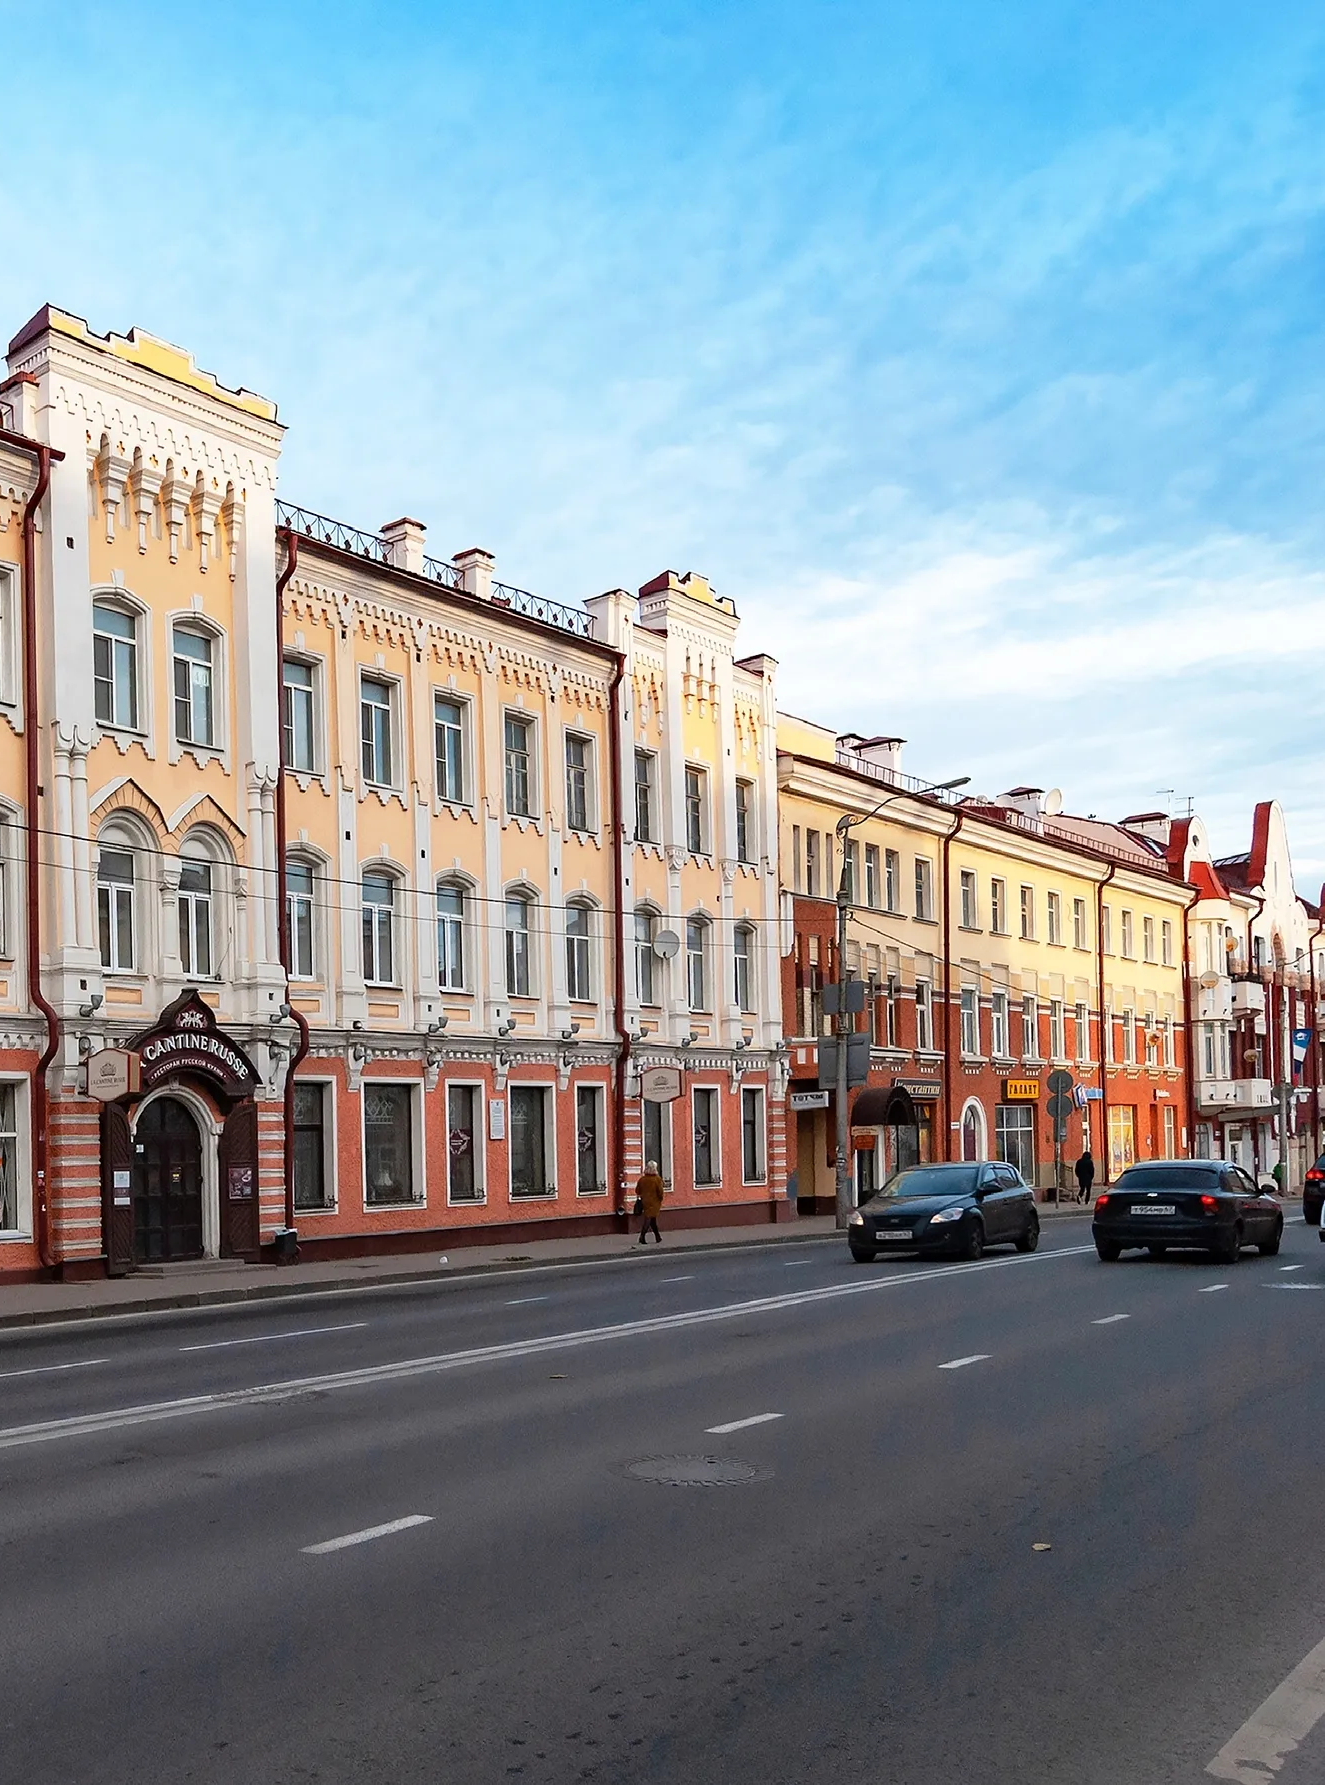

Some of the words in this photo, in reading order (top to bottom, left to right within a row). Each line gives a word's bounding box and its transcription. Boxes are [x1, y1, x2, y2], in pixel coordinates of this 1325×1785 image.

[146, 1034, 208, 1061] CANTINE
[209, 1039, 249, 1080] RUSSE
[154, 1060, 181, 1079] РЕСТОРАН
[1009, 1084, 1037, 1095] ГАЛАНТ
